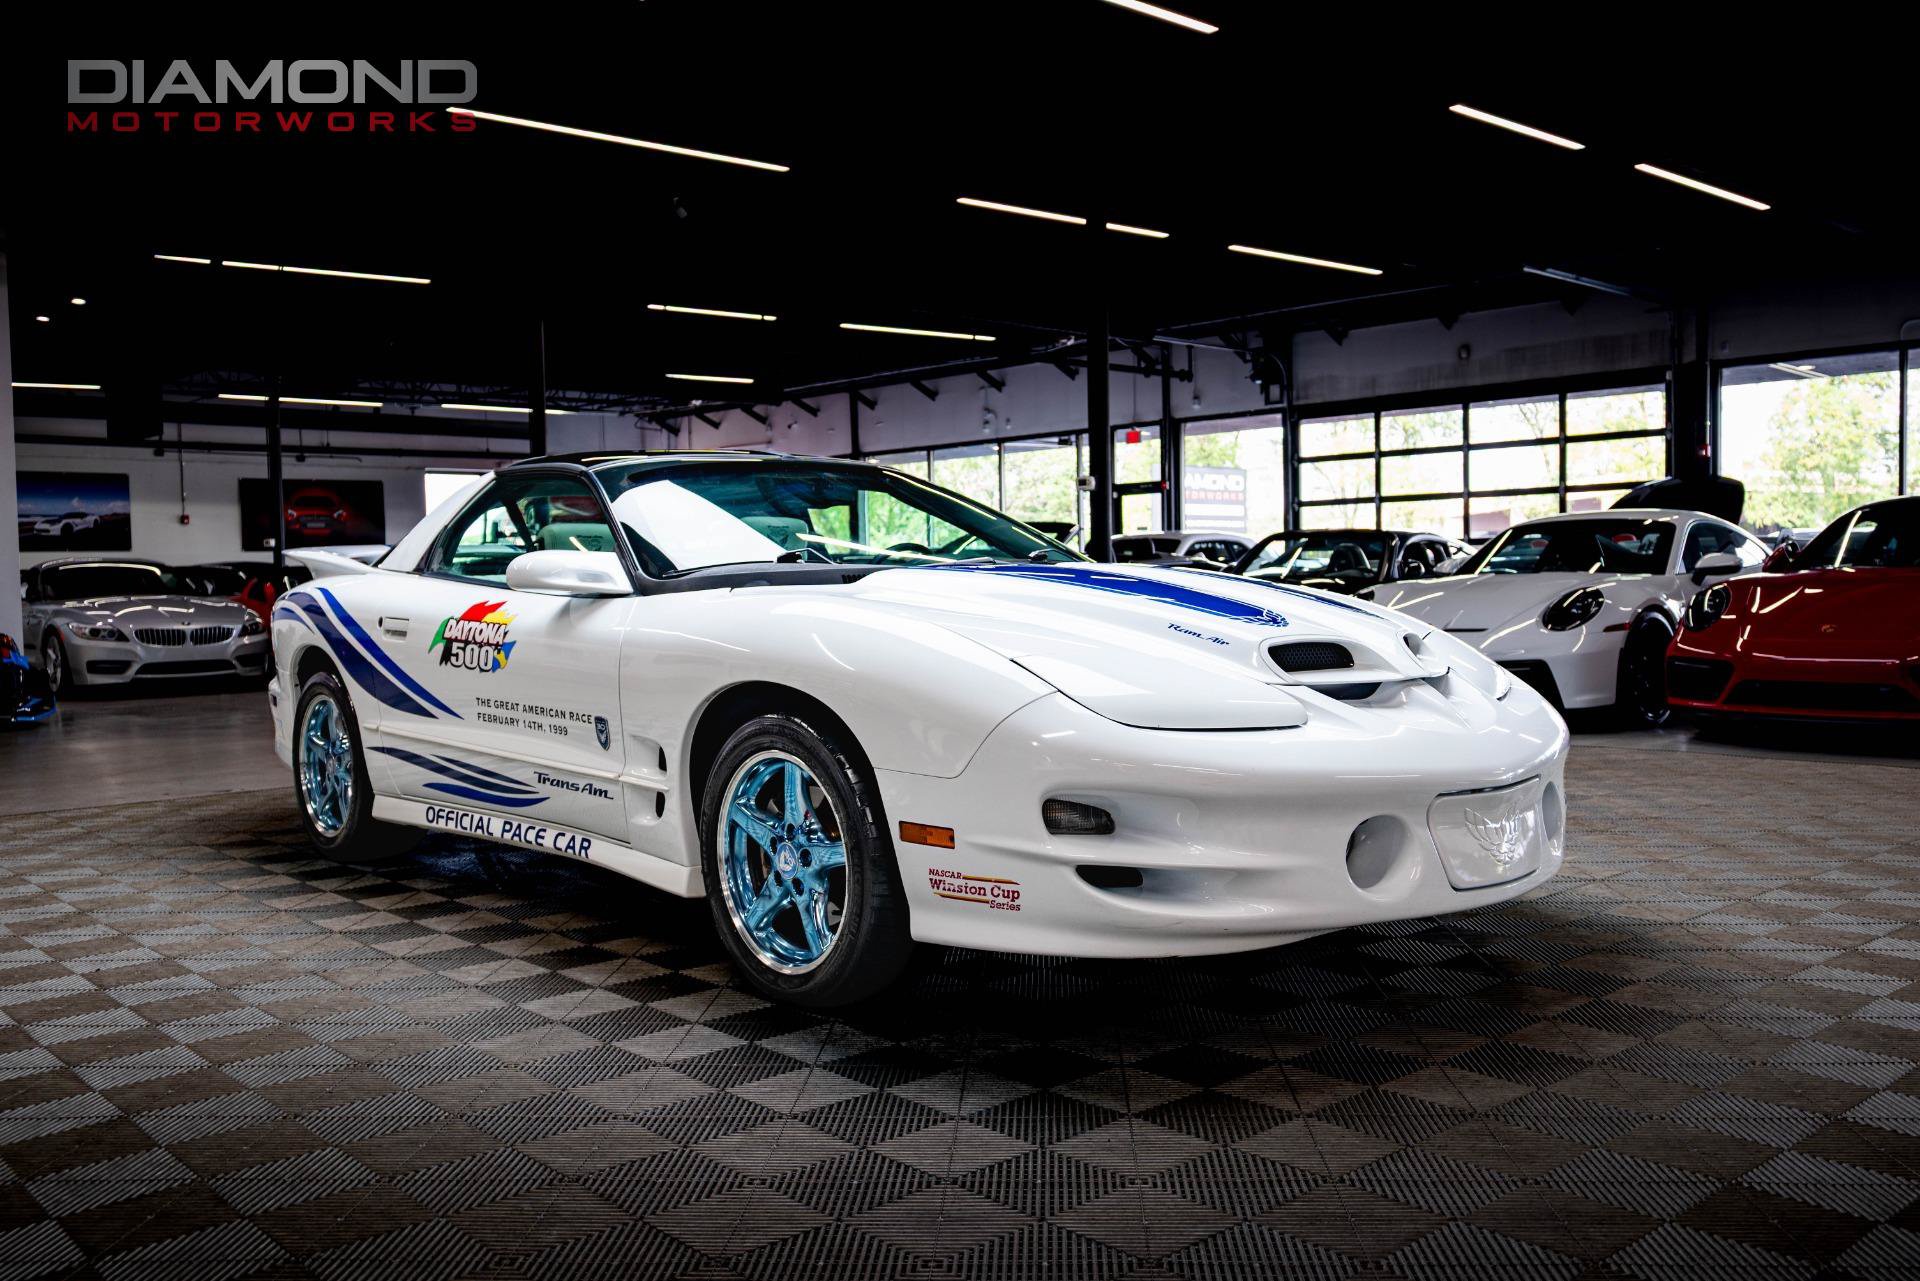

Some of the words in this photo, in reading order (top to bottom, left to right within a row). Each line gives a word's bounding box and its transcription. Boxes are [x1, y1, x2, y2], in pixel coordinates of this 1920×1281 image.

[1184, 472, 1245, 492] AMOND
[443, 618, 507, 646] DAYTONA
[1167, 622, 1205, 640] Ram
[1205, 636, 1230, 645] Air
[450, 641, 495, 672] 500
[475, 697, 492, 708] THE
[493, 699, 520, 712] GREAT
[522, 704, 566, 720] AMERICAN
[568, 711, 593, 725] RACE
[477, 712, 520, 728] FEBRUARY
[522, 719, 547, 734] 14TH,
[548, 724, 569, 736] 1999
[533, 771, 580, 793] Trans
[580, 782, 615, 800] Am
[425, 805, 494, 837] OFFICIAL
[500, 820, 547, 847] PACE
[552, 832, 592, 859] CAR
[928, 867, 962, 880] NASCAR
[928, 877, 987, 897] Winston
[990, 884, 1021, 903] Cup
[989, 900, 1021, 912] Series
